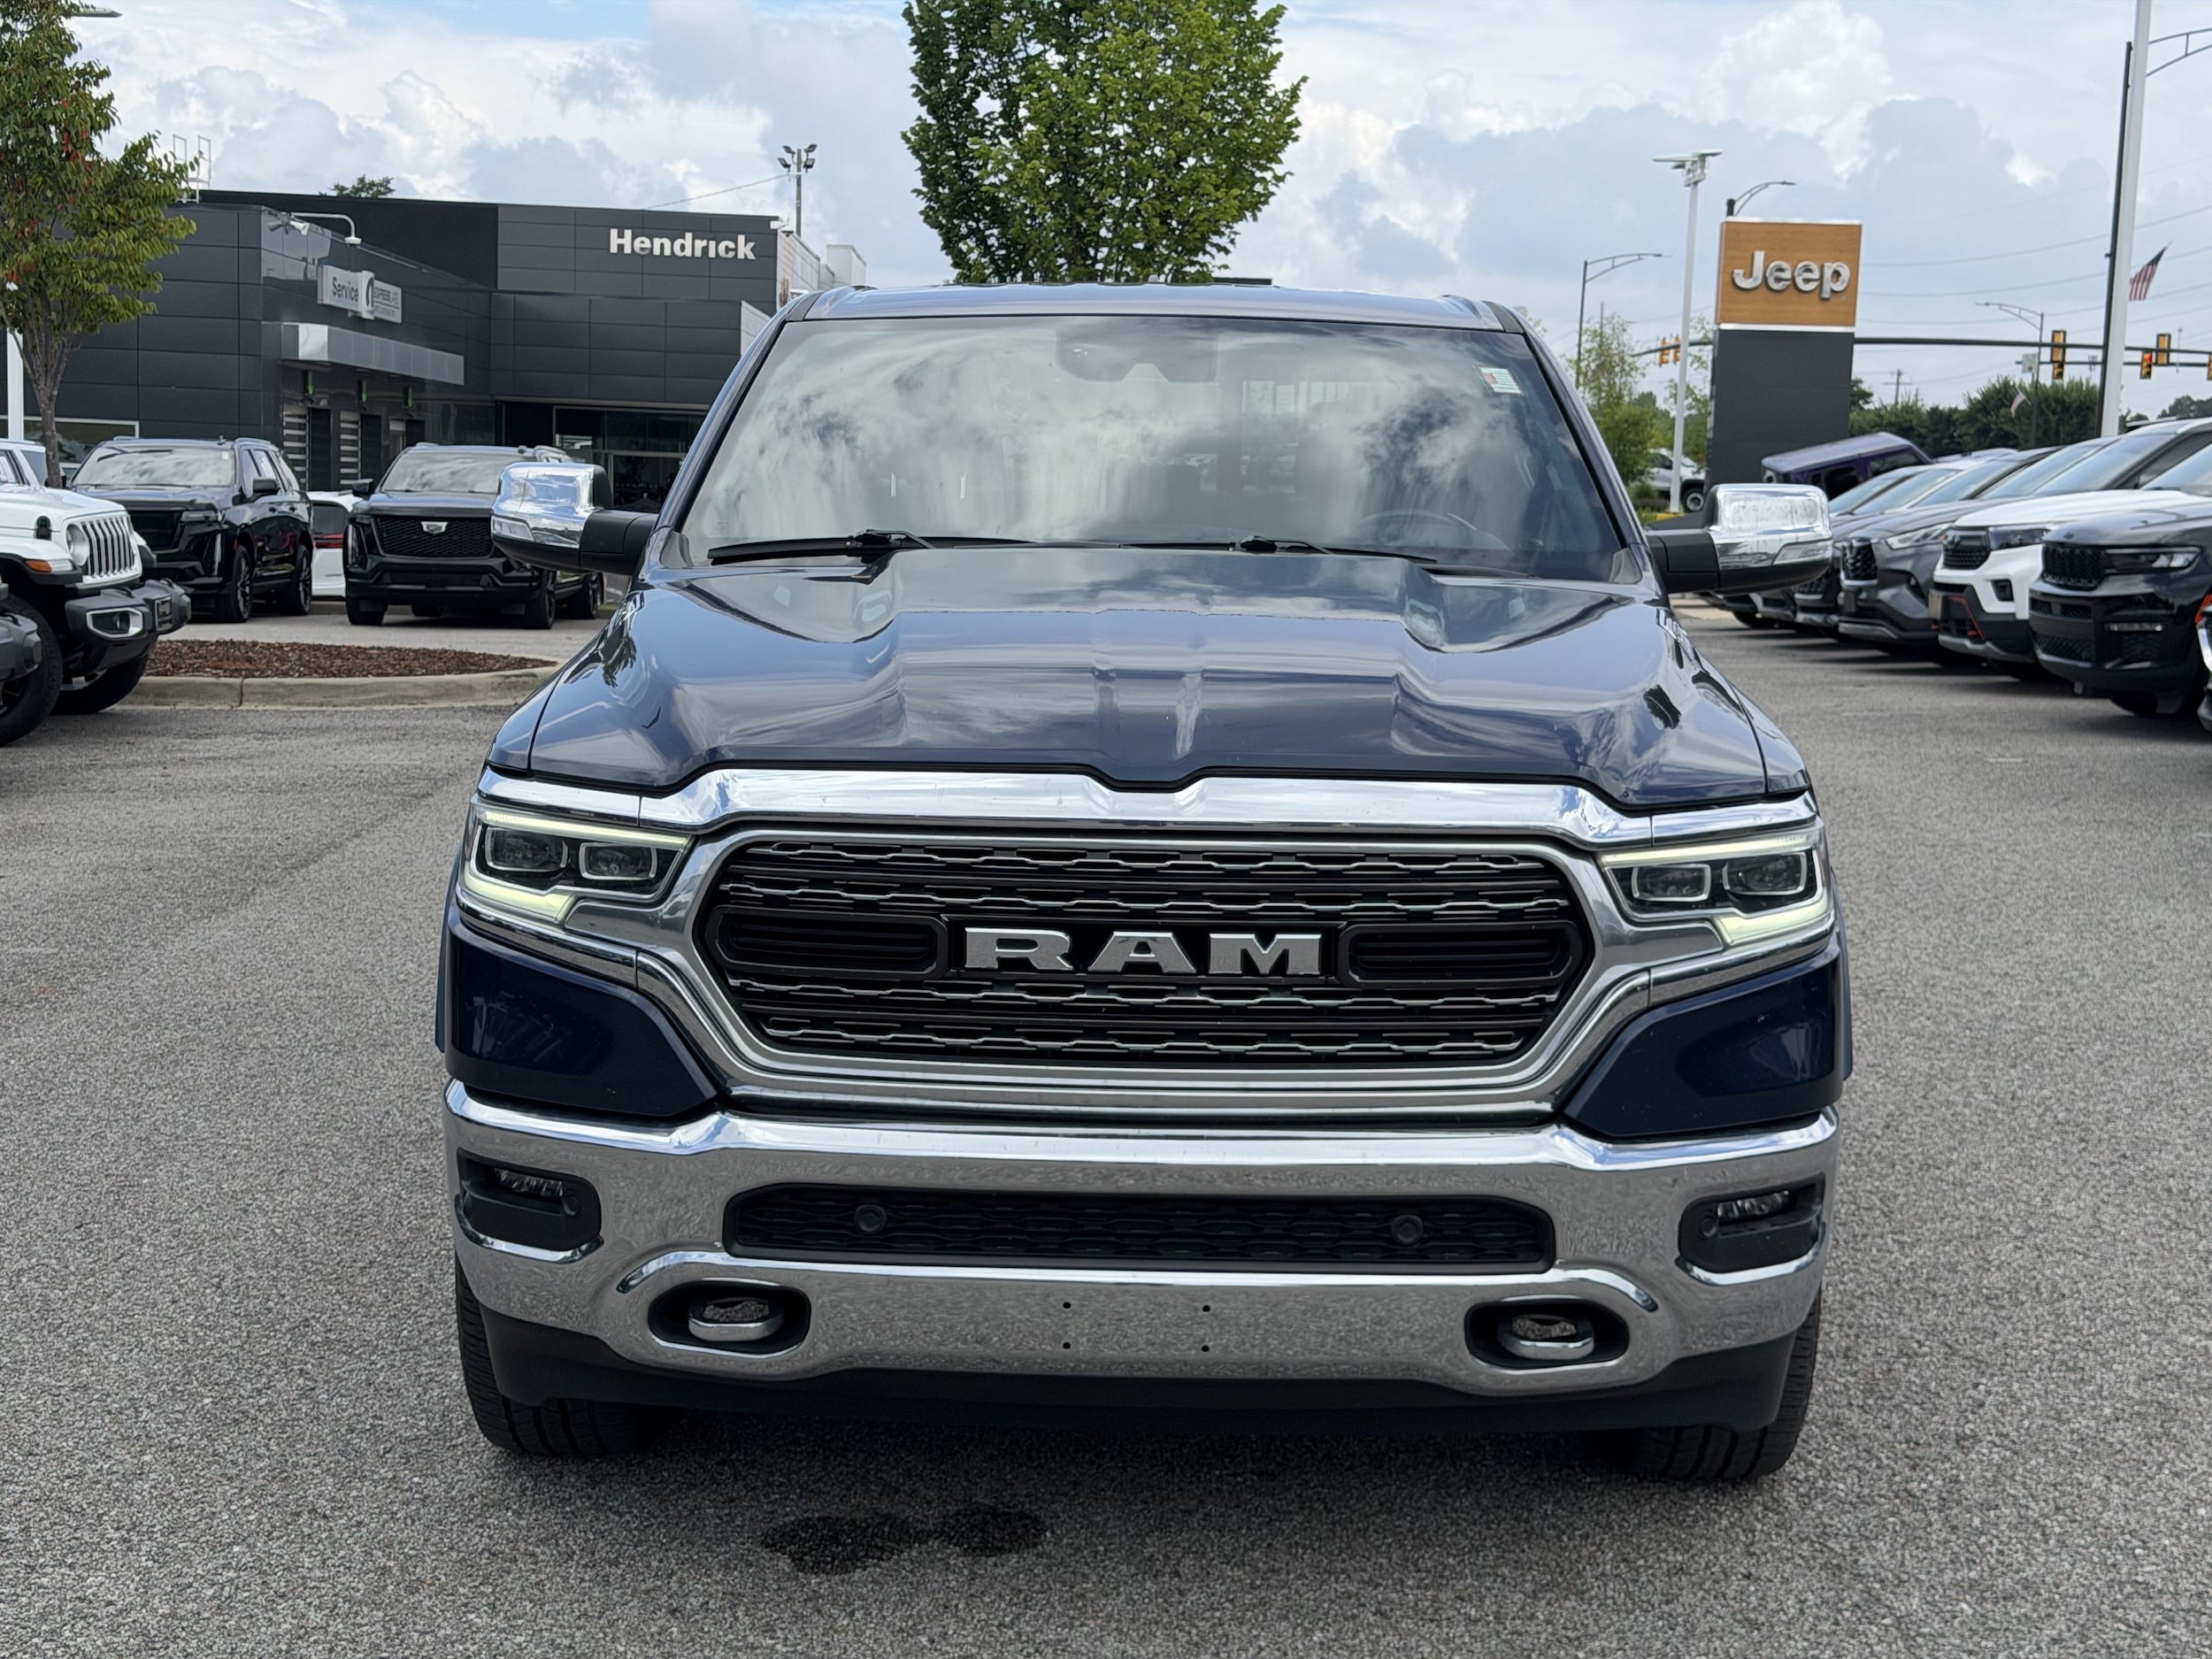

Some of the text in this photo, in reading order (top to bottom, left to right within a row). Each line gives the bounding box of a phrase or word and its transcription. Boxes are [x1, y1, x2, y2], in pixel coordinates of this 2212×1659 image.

[610, 227, 756, 260] Hendrick
[332, 276, 359, 303] Service
[1732, 250, 1851, 299] Jeep
[964, 926, 1322, 974] RAM
